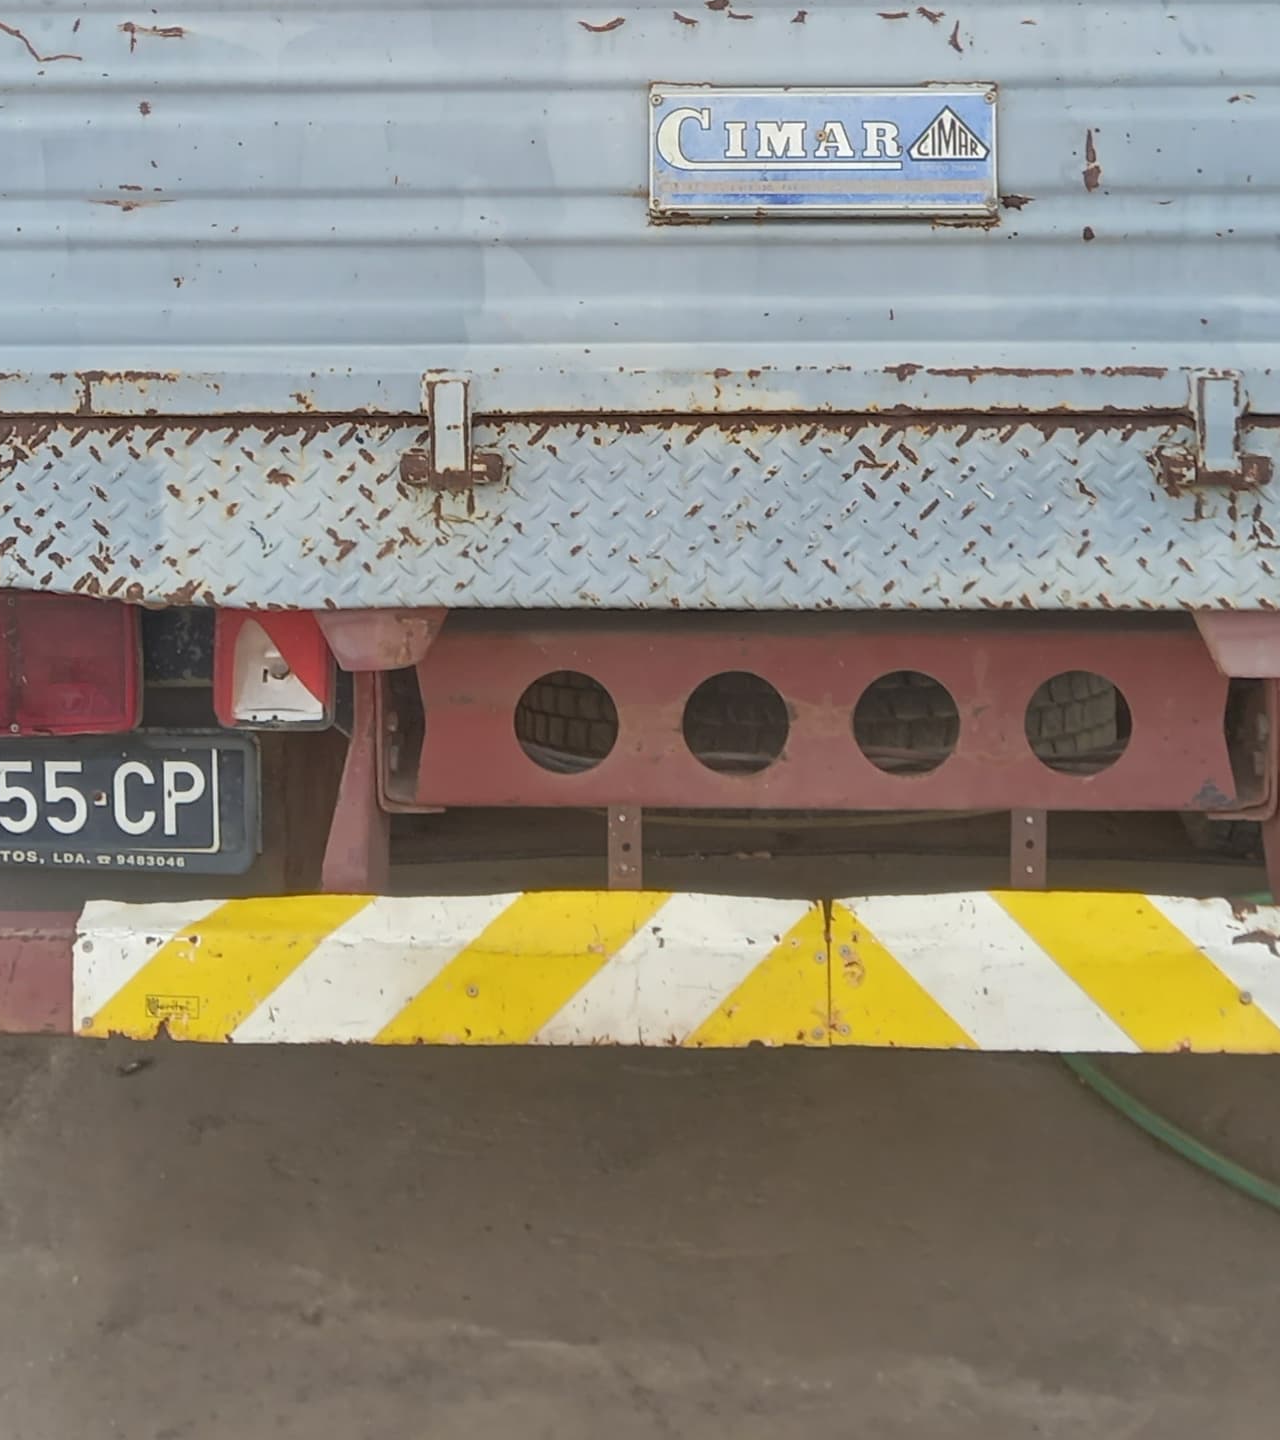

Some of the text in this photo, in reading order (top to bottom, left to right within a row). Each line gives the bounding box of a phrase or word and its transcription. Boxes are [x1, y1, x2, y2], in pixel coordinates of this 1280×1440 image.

[656, 107, 980, 171] CIMAR CIMAR
[53, 852, 91, 864] LDA.
